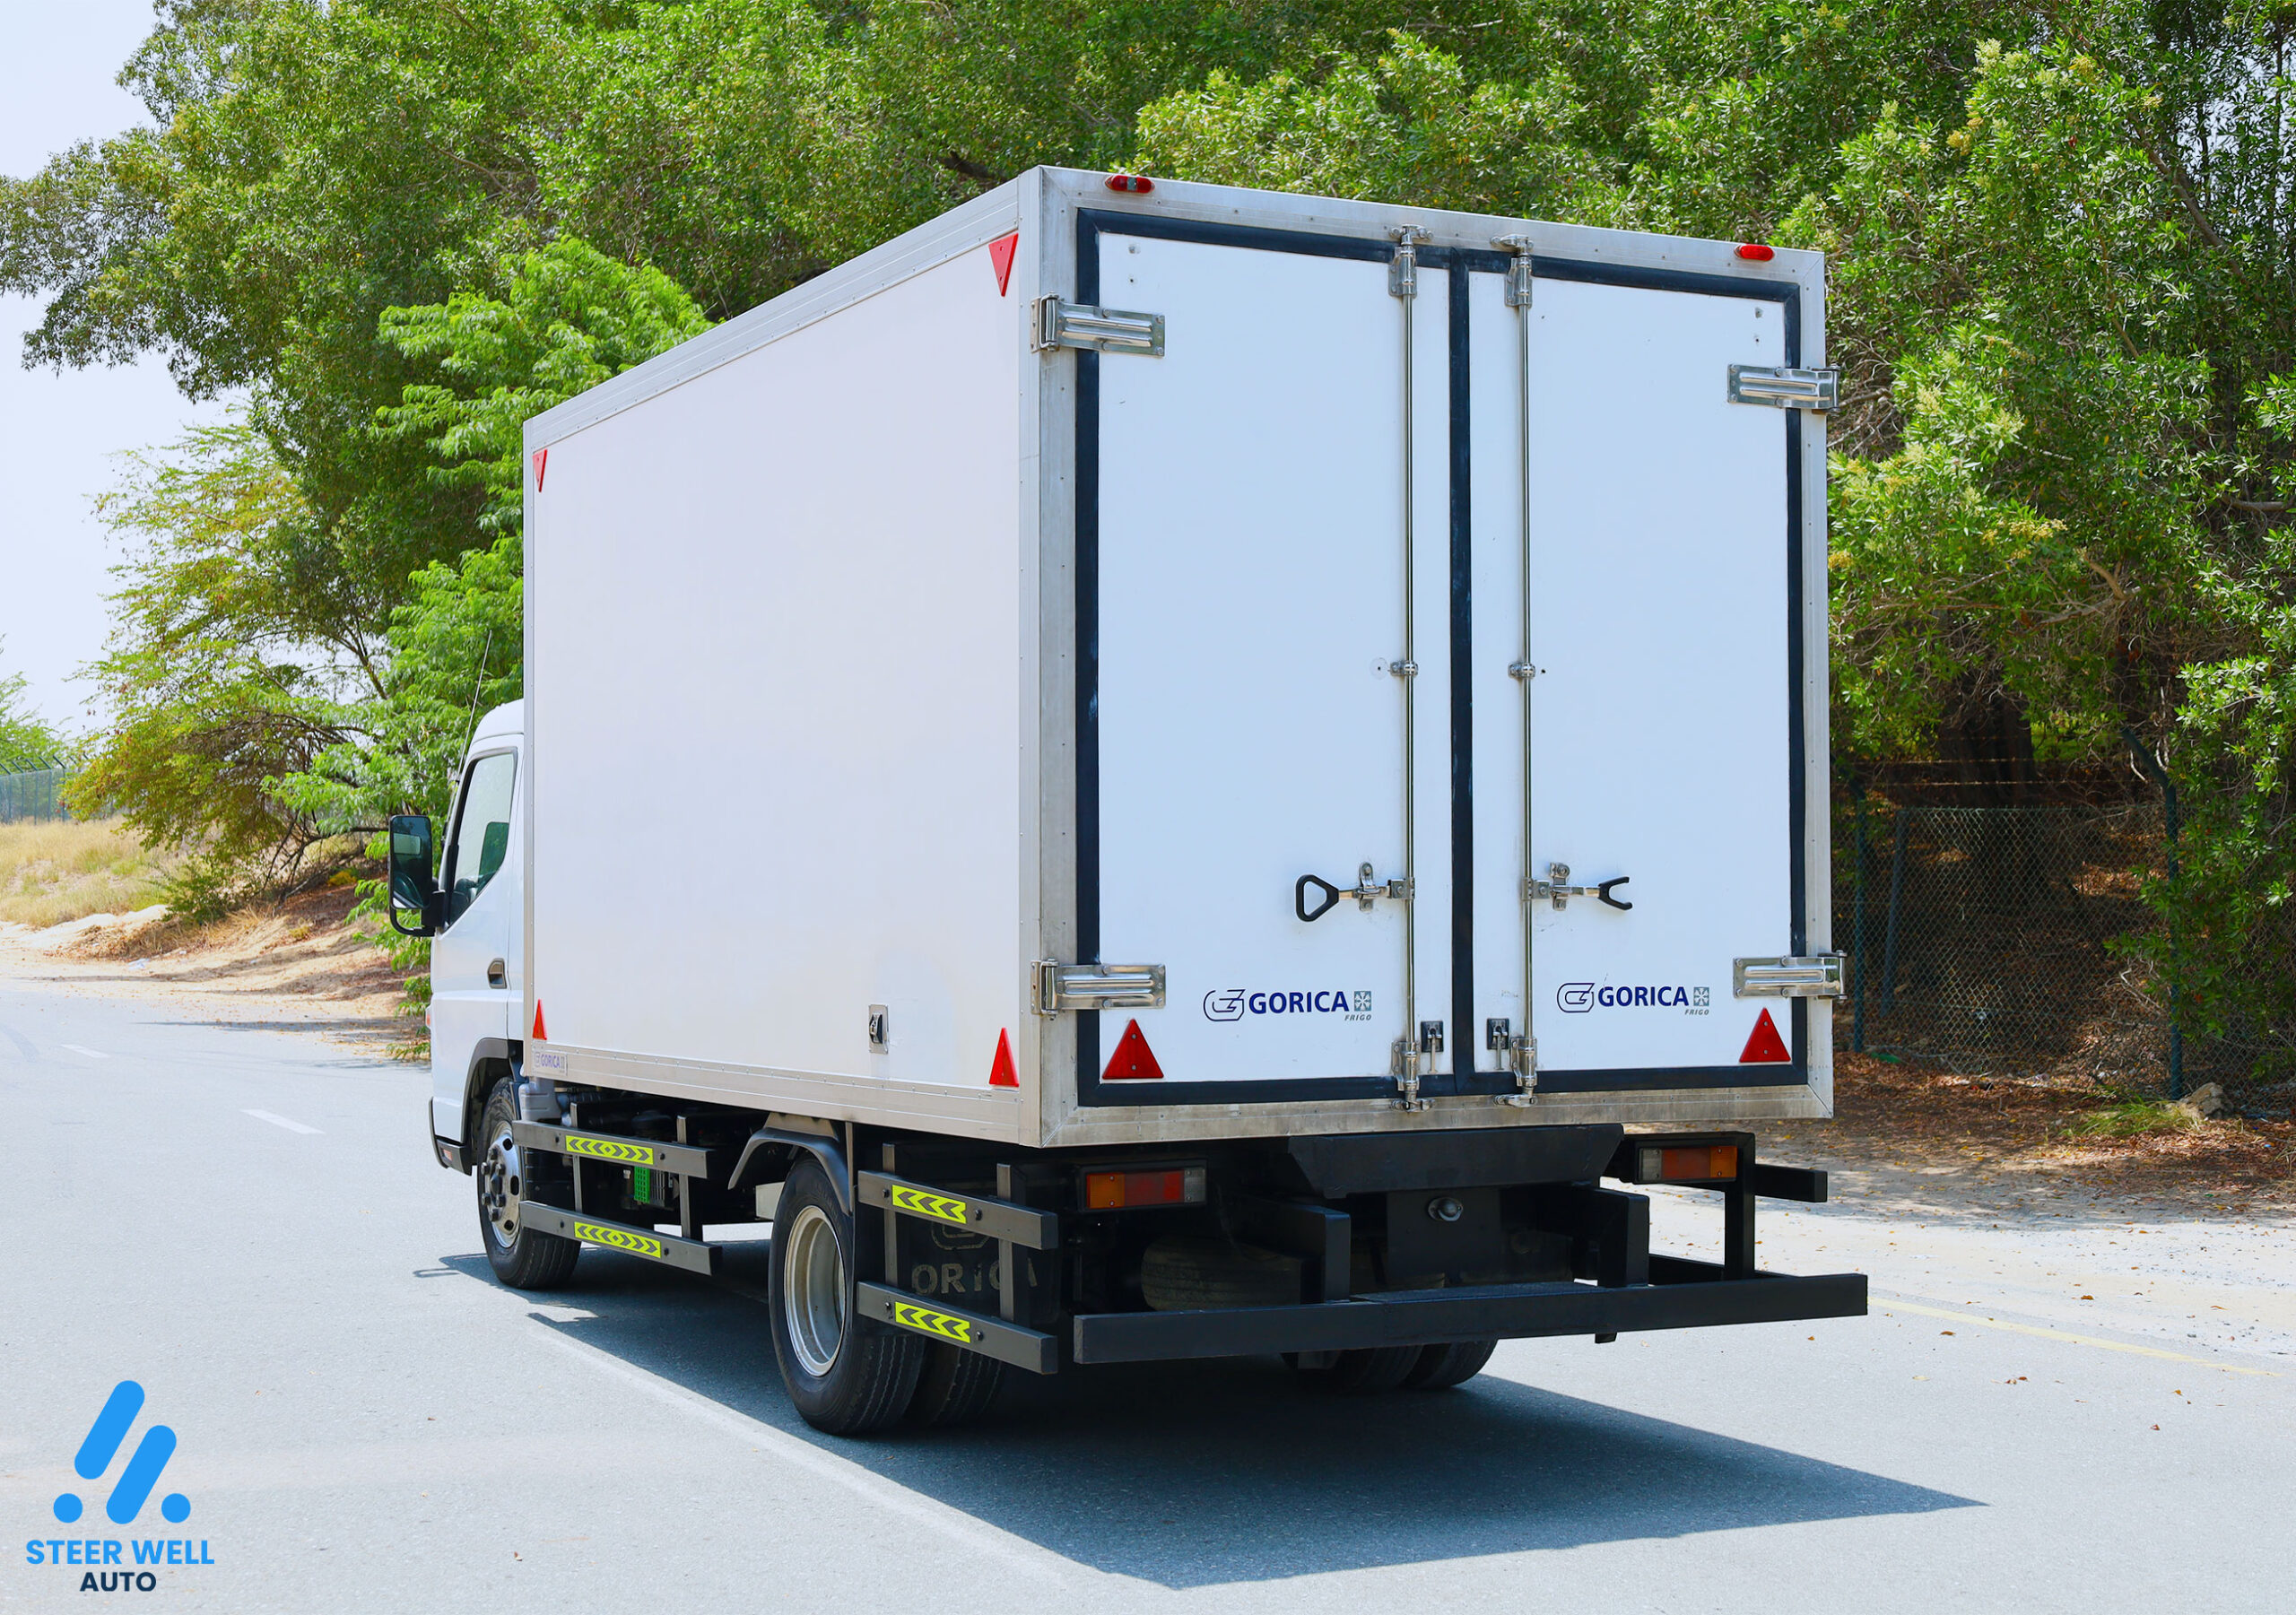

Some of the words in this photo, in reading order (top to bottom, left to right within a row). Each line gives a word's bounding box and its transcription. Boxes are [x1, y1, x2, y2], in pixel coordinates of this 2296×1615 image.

[1248, 990, 1350, 1014] GORICA
[1597, 985, 1690, 1007] GORICA
[1344, 1013, 1372, 1021] FRIGO
[540, 1054, 561, 1068] GORICA
